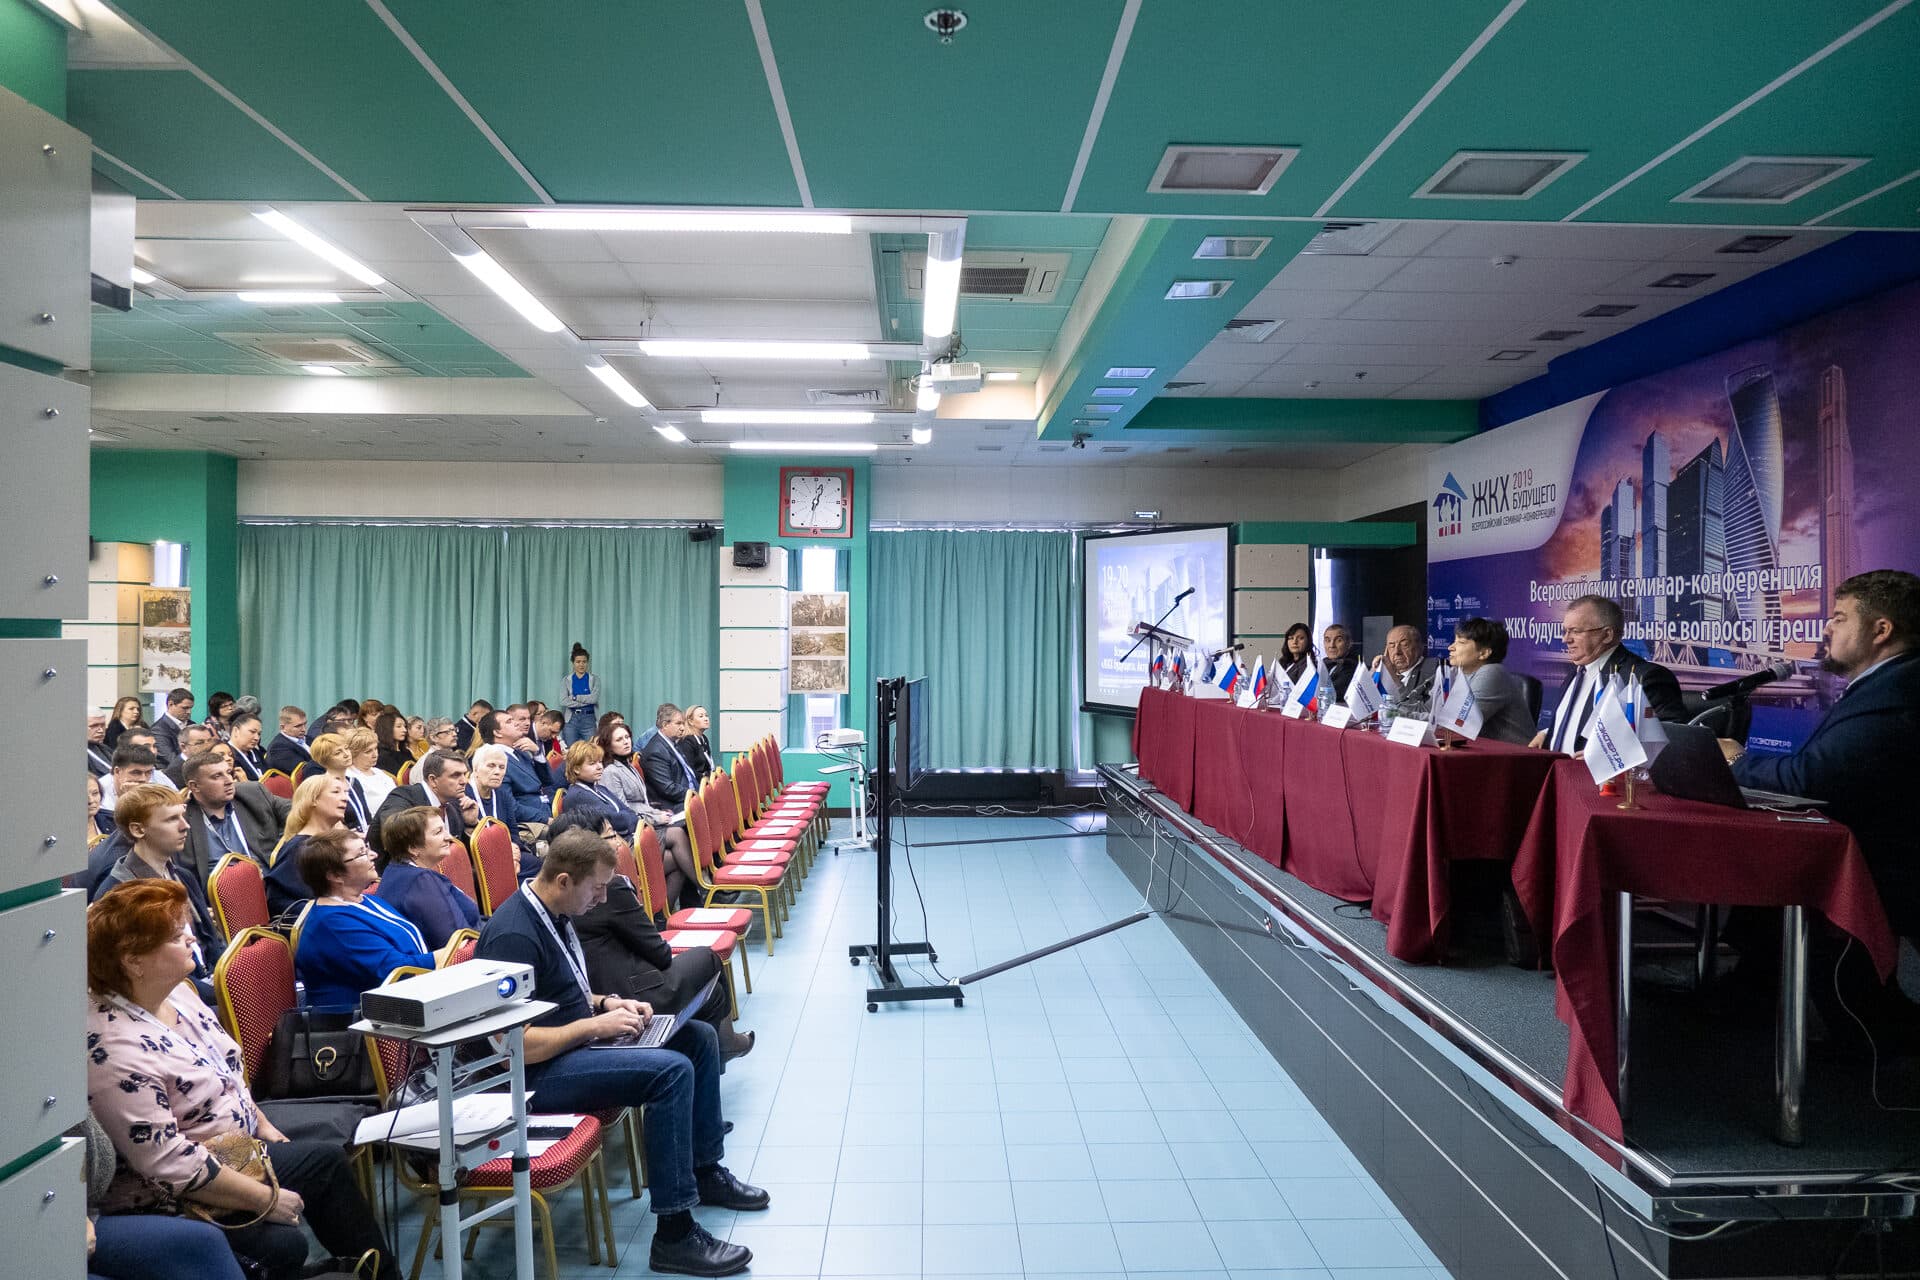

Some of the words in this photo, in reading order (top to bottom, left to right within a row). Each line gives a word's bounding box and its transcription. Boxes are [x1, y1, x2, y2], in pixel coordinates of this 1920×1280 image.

[1512, 468, 1533, 490] 2019
[1472, 474, 1510, 518] ЖКХ
[1512, 483, 1556, 511] БУДУЩЕГО
[1530, 574, 1617, 607] Всероссийский
[1620, 564, 1823, 602] семинар-конференция
[1505, 617, 1527, 639] ЖКХ
[1528, 616, 1565, 646] будущ
[1680, 619, 1757, 649] вопросы
[1762, 619, 1774, 642] и
